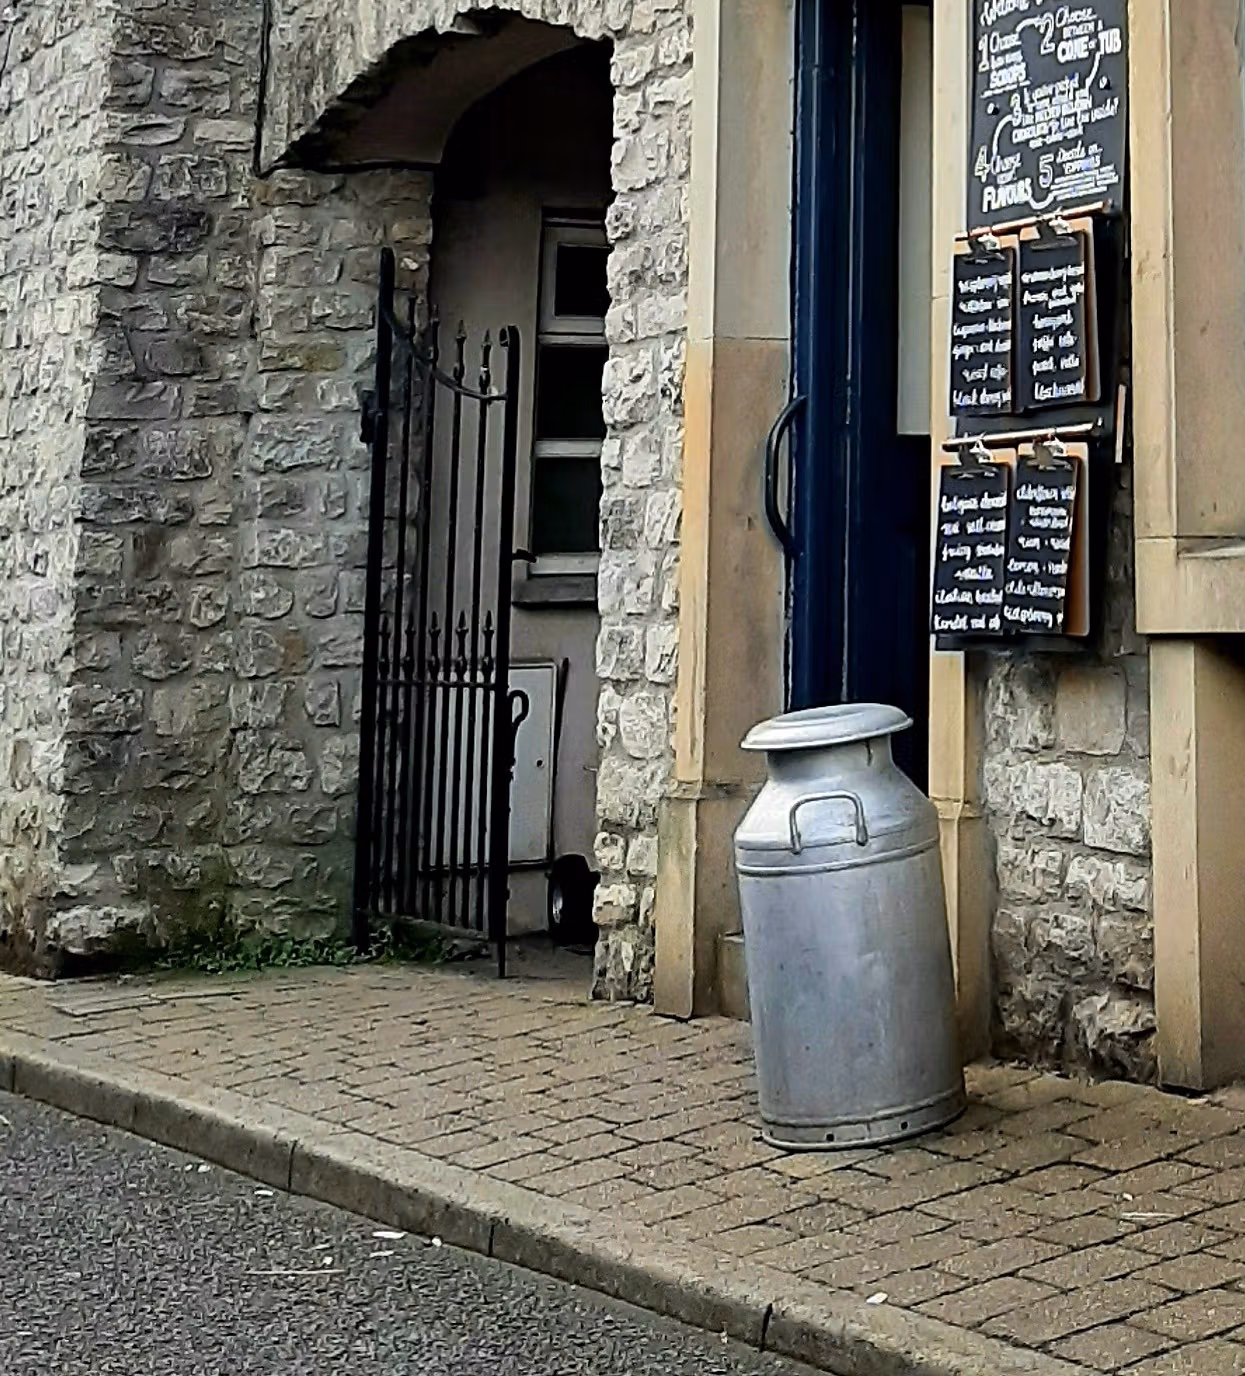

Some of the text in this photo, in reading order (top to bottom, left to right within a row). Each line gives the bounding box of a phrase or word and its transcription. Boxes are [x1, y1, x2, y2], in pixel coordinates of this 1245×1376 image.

[1057, 35, 1089, 63] CONE
[1098, 27, 1121, 55] TUB
[1039, 153, 1054, 188] 5
